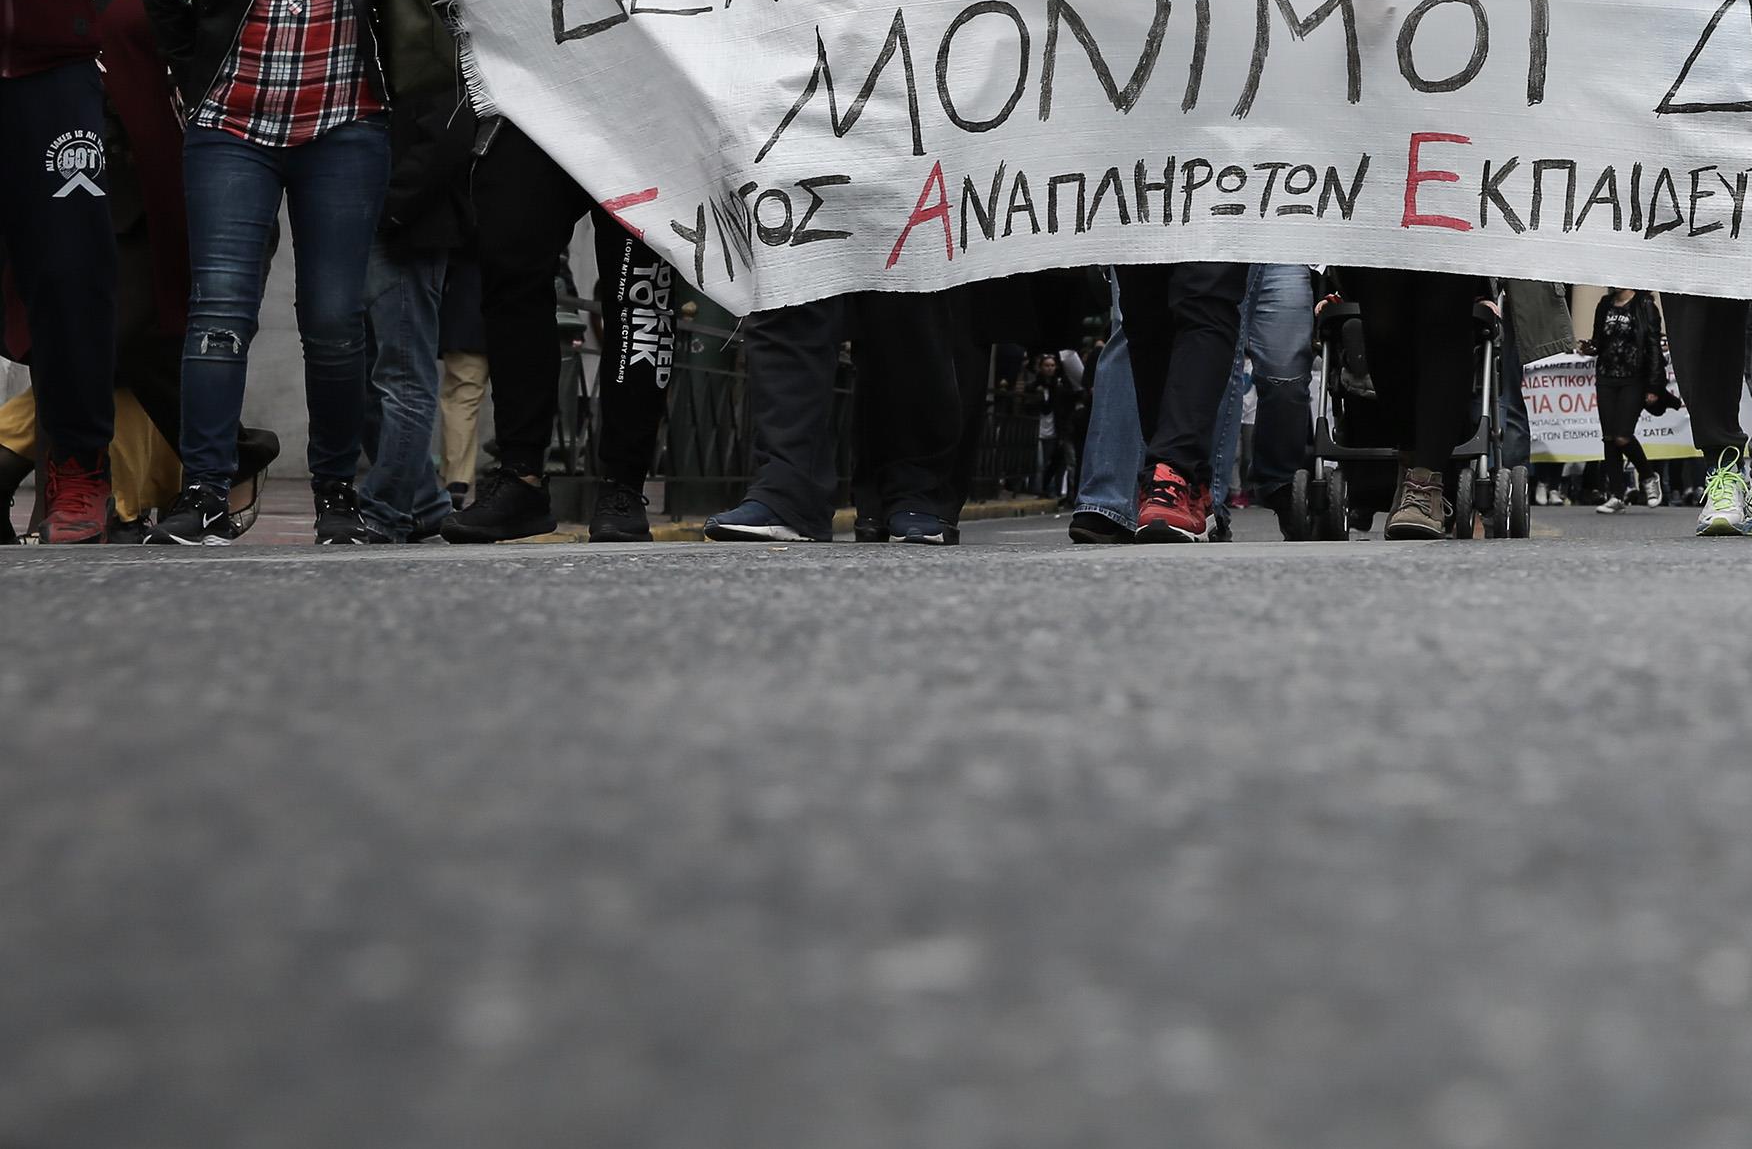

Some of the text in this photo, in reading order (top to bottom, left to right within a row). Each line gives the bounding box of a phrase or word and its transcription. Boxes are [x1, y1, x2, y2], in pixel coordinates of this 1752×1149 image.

[63, 148, 98, 169] GOT
[886, 152, 1371, 269] ΑΝΑΠΛΗΡΩΤΩΝ
[1520, 375, 1597, 389] ΑΙΔΕΥΤΙΚΟΥ
[1643, 428, 1674, 437] ΣΑΤΕΑ
